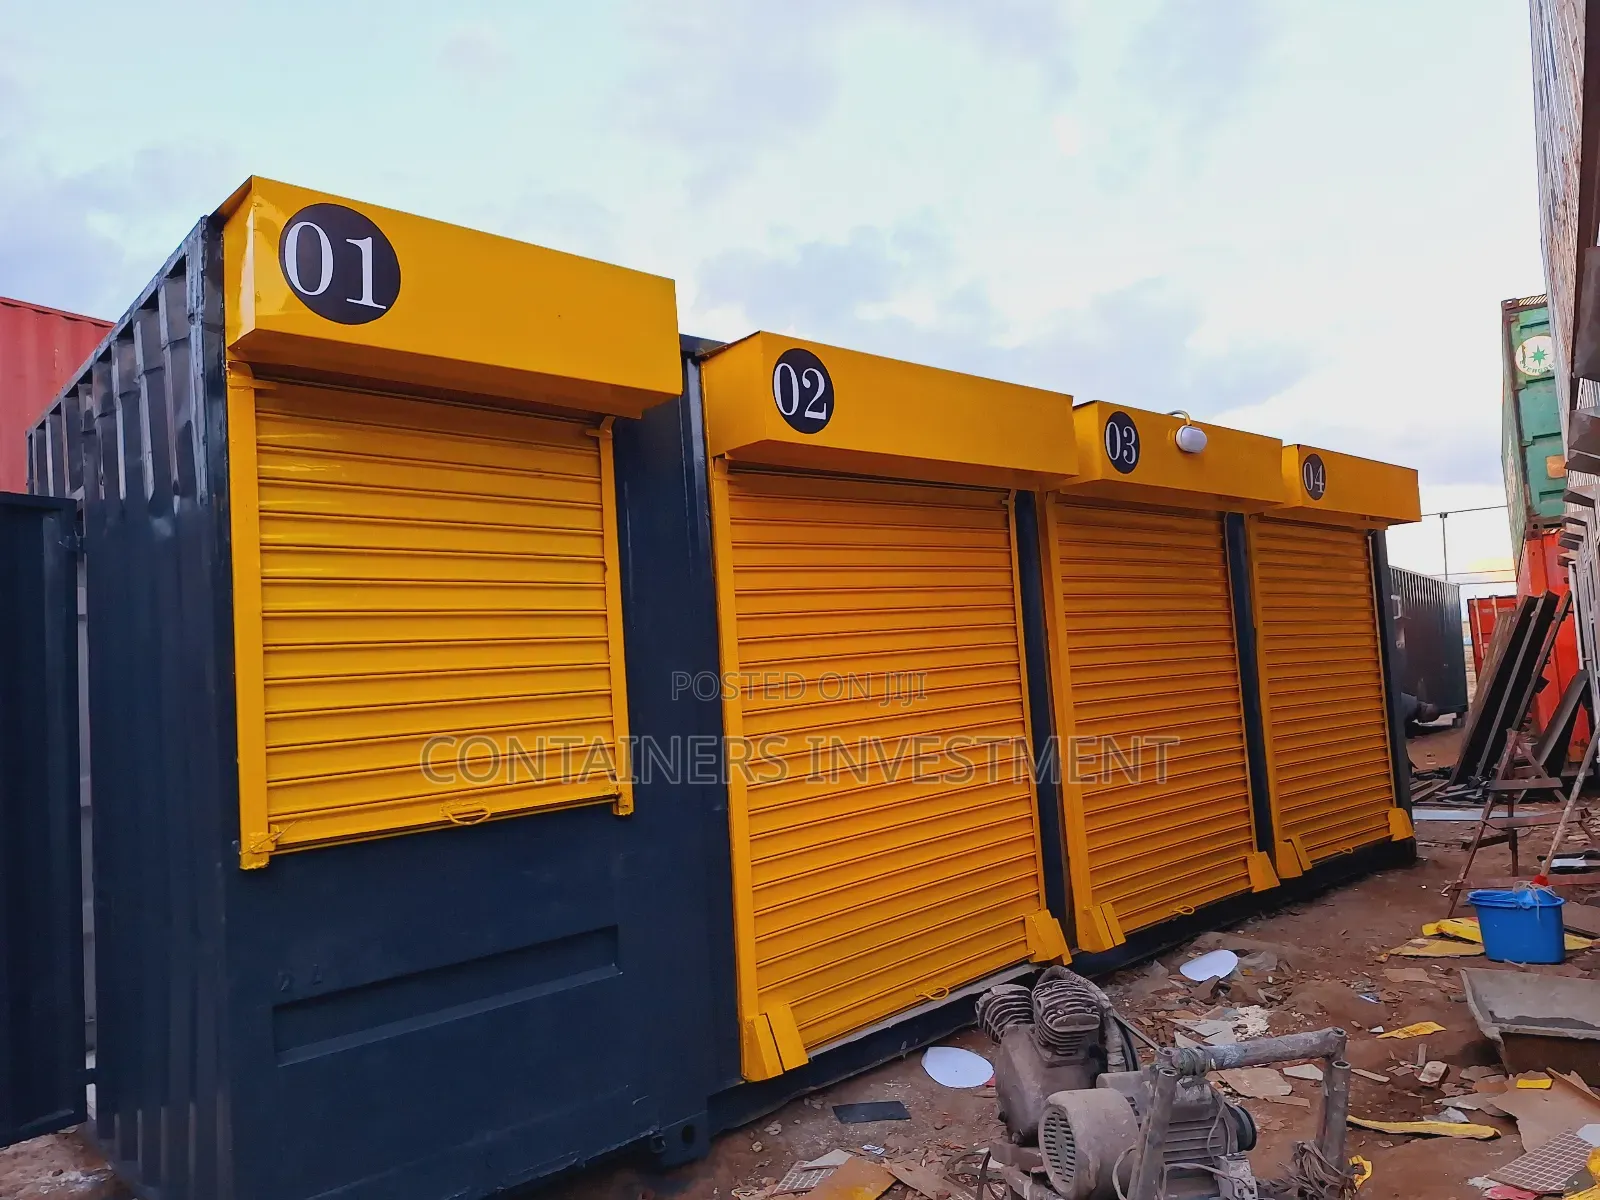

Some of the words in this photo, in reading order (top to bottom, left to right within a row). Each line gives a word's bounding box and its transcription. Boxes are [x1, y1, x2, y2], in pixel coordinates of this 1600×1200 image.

[284, 221, 387, 310] 01
[773, 362, 827, 420] 02
[1105, 421, 1136, 465] 03
[1303, 462, 1325, 494] 04
